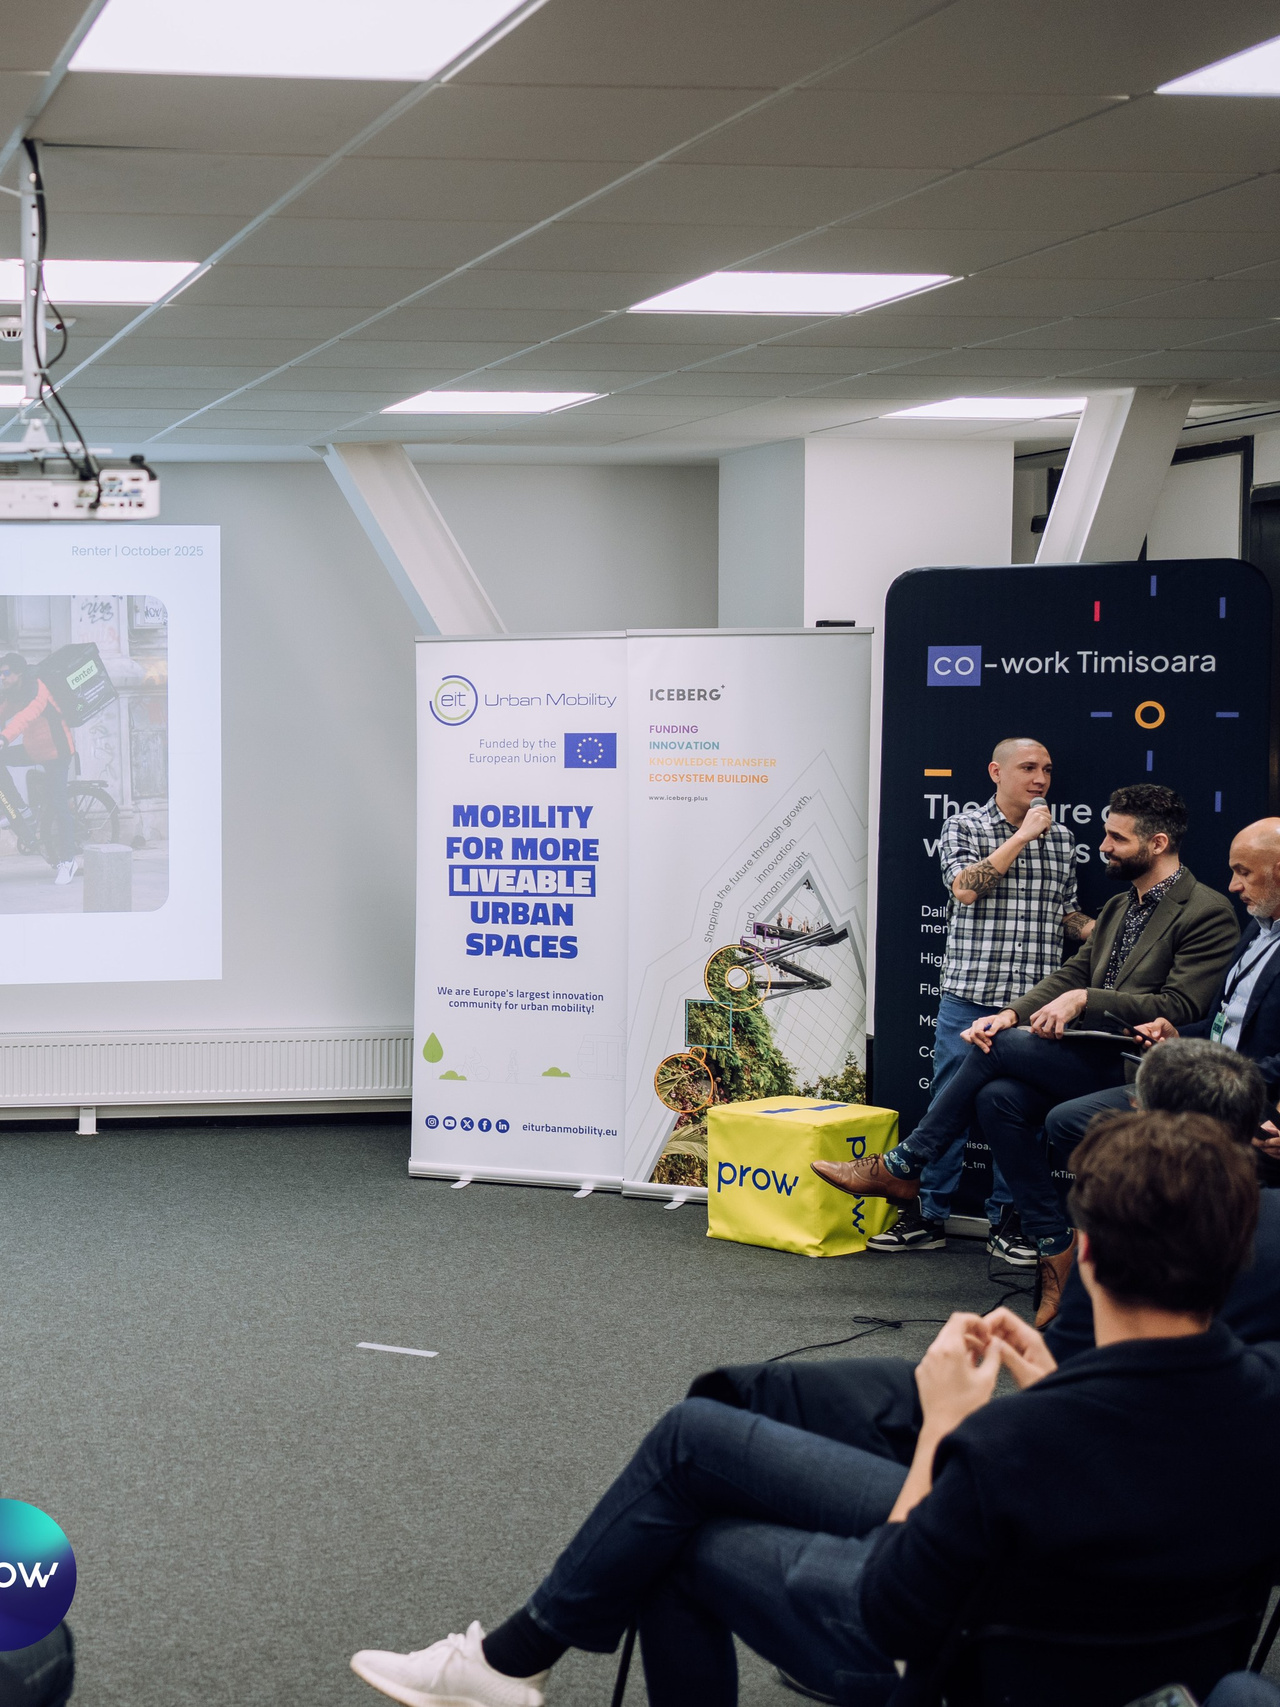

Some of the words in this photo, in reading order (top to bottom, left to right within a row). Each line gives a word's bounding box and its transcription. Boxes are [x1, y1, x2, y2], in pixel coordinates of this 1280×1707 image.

[71, 545, 112, 556] Renter
[120, 545, 171, 557] October
[174, 545, 204, 557] 2025
[1076, 650, 1217, 674] Timisoara
[71, 665, 94, 686] renter
[441, 691, 466, 707] eit
[484, 693, 542, 707] Urban
[546, 693, 617, 708] Mobility
[649, 725, 699, 734] FUNDING
[479, 739, 519, 749] Funded
[522, 739, 535, 750] by
[538, 739, 557, 749] the
[649, 741, 720, 750] INNOVATION
[469, 753, 520, 765] European
[523, 753, 557, 764] Union
[649, 757, 718, 767] KNOWLEDGE
[721, 758, 777, 767] TRANSFER
[649, 773, 715, 783] ECOSYSTEM
[717, 774, 769, 784] BUILDING
[452, 804, 594, 829] MOBILITY
[446, 836, 504, 860] FOR
[511, 837, 600, 862] MORE
[704, 900, 723, 943] Shaping
[717, 883, 732, 900] the
[729, 858, 754, 886] future
[752, 825, 784, 860] through
[782, 794, 813, 828] growth,
[754, 838, 797, 884] innovation
[453, 868, 592, 895] LIVEABLE
[745, 911, 755, 933] and
[753, 881, 783, 912] human
[781, 851, 811, 881] insight.
[470, 901, 574, 926] URBAN
[921, 905, 946, 918] Dail
[466, 932, 579, 960] SPACES
[437, 986, 453, 996] We
[455, 987, 470, 997] are
[473, 987, 514, 1000] Europe's
[516, 988, 550, 1001] largest
[552, 990, 604, 1002] innovation
[448, 1000, 502, 1012] community
[504, 1000, 519, 1010] for
[520, 1000, 549, 1012] urban
[551, 1001, 595, 1015] mobility!
[522, 1122, 618, 1137] eiturbanmobility.eu
[717, 1161, 799, 1196] prow
